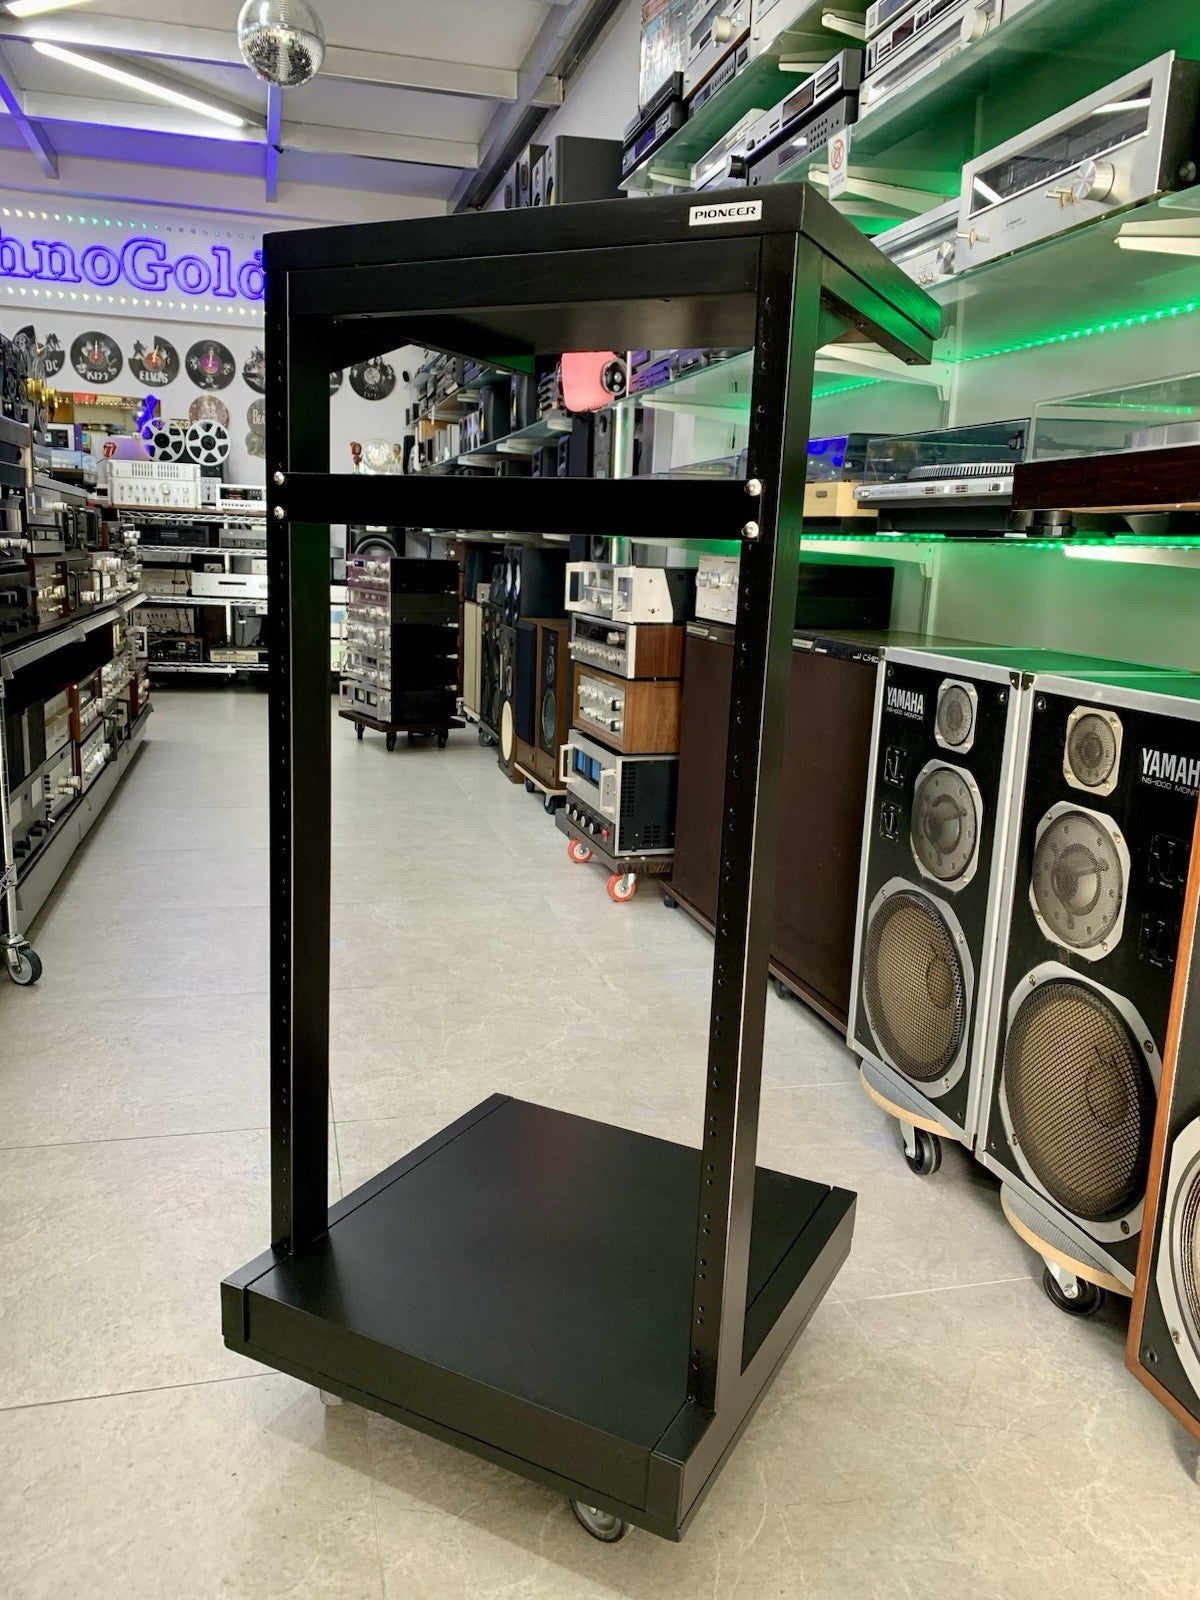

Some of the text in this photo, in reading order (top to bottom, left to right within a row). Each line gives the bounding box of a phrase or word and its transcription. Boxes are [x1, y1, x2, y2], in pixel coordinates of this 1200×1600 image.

[694, 206, 756, 220] PIONEER
[887, 686, 924, 715] YAMAHA
[1142, 747, 1200, 788] YAMAH
[1142, 776, 1172, 790] NS-1000
